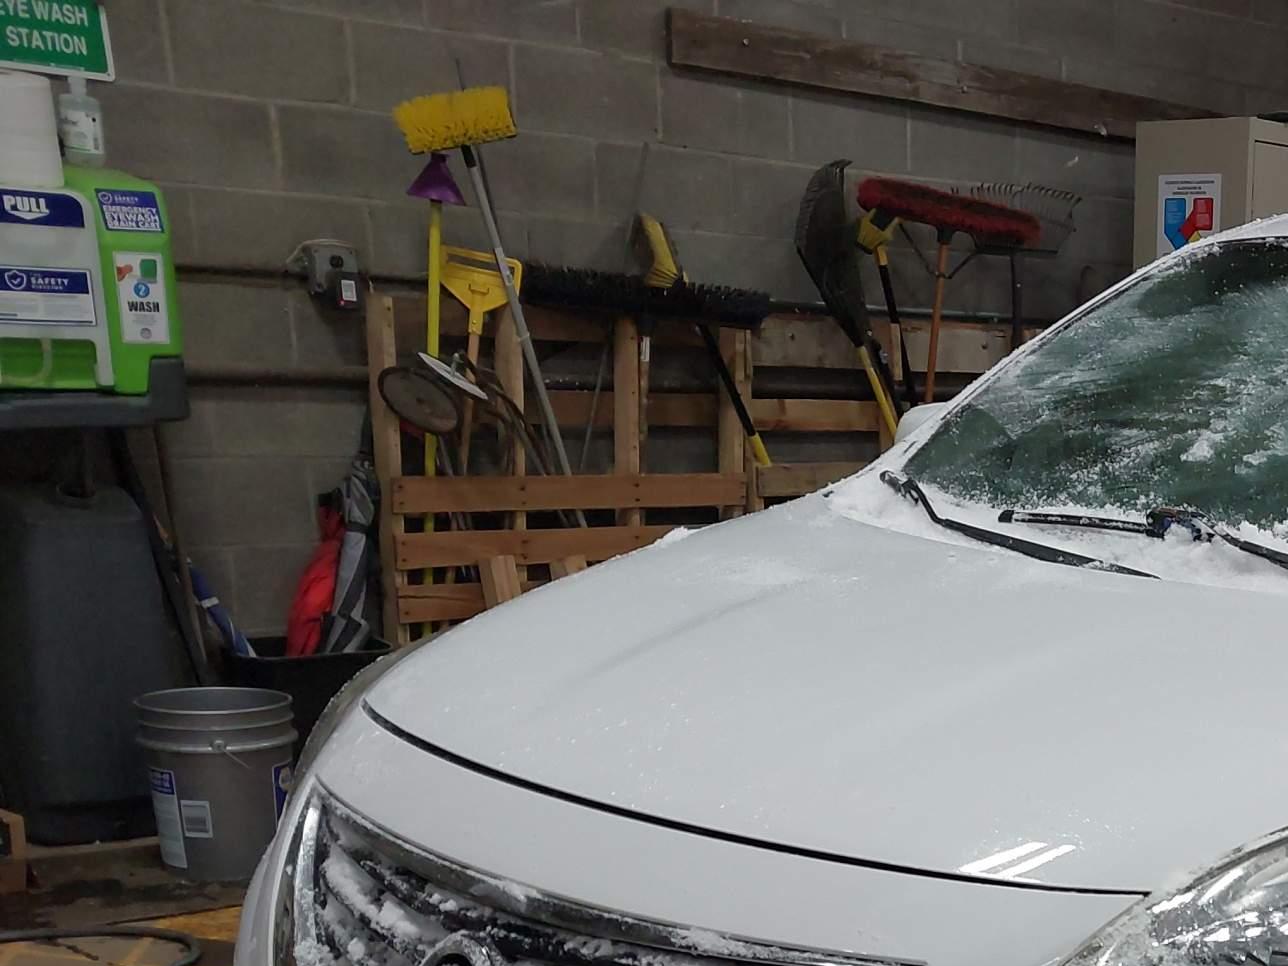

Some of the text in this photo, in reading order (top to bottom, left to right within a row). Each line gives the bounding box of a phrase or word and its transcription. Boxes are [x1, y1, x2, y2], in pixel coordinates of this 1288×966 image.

[31, 0, 88, 26] WASH
[6, 25, 87, 56] STATION
[2, 194, 49, 213] PULL
[30, 278, 69, 287] SAFETY
[127, 301, 160, 313] WASH
